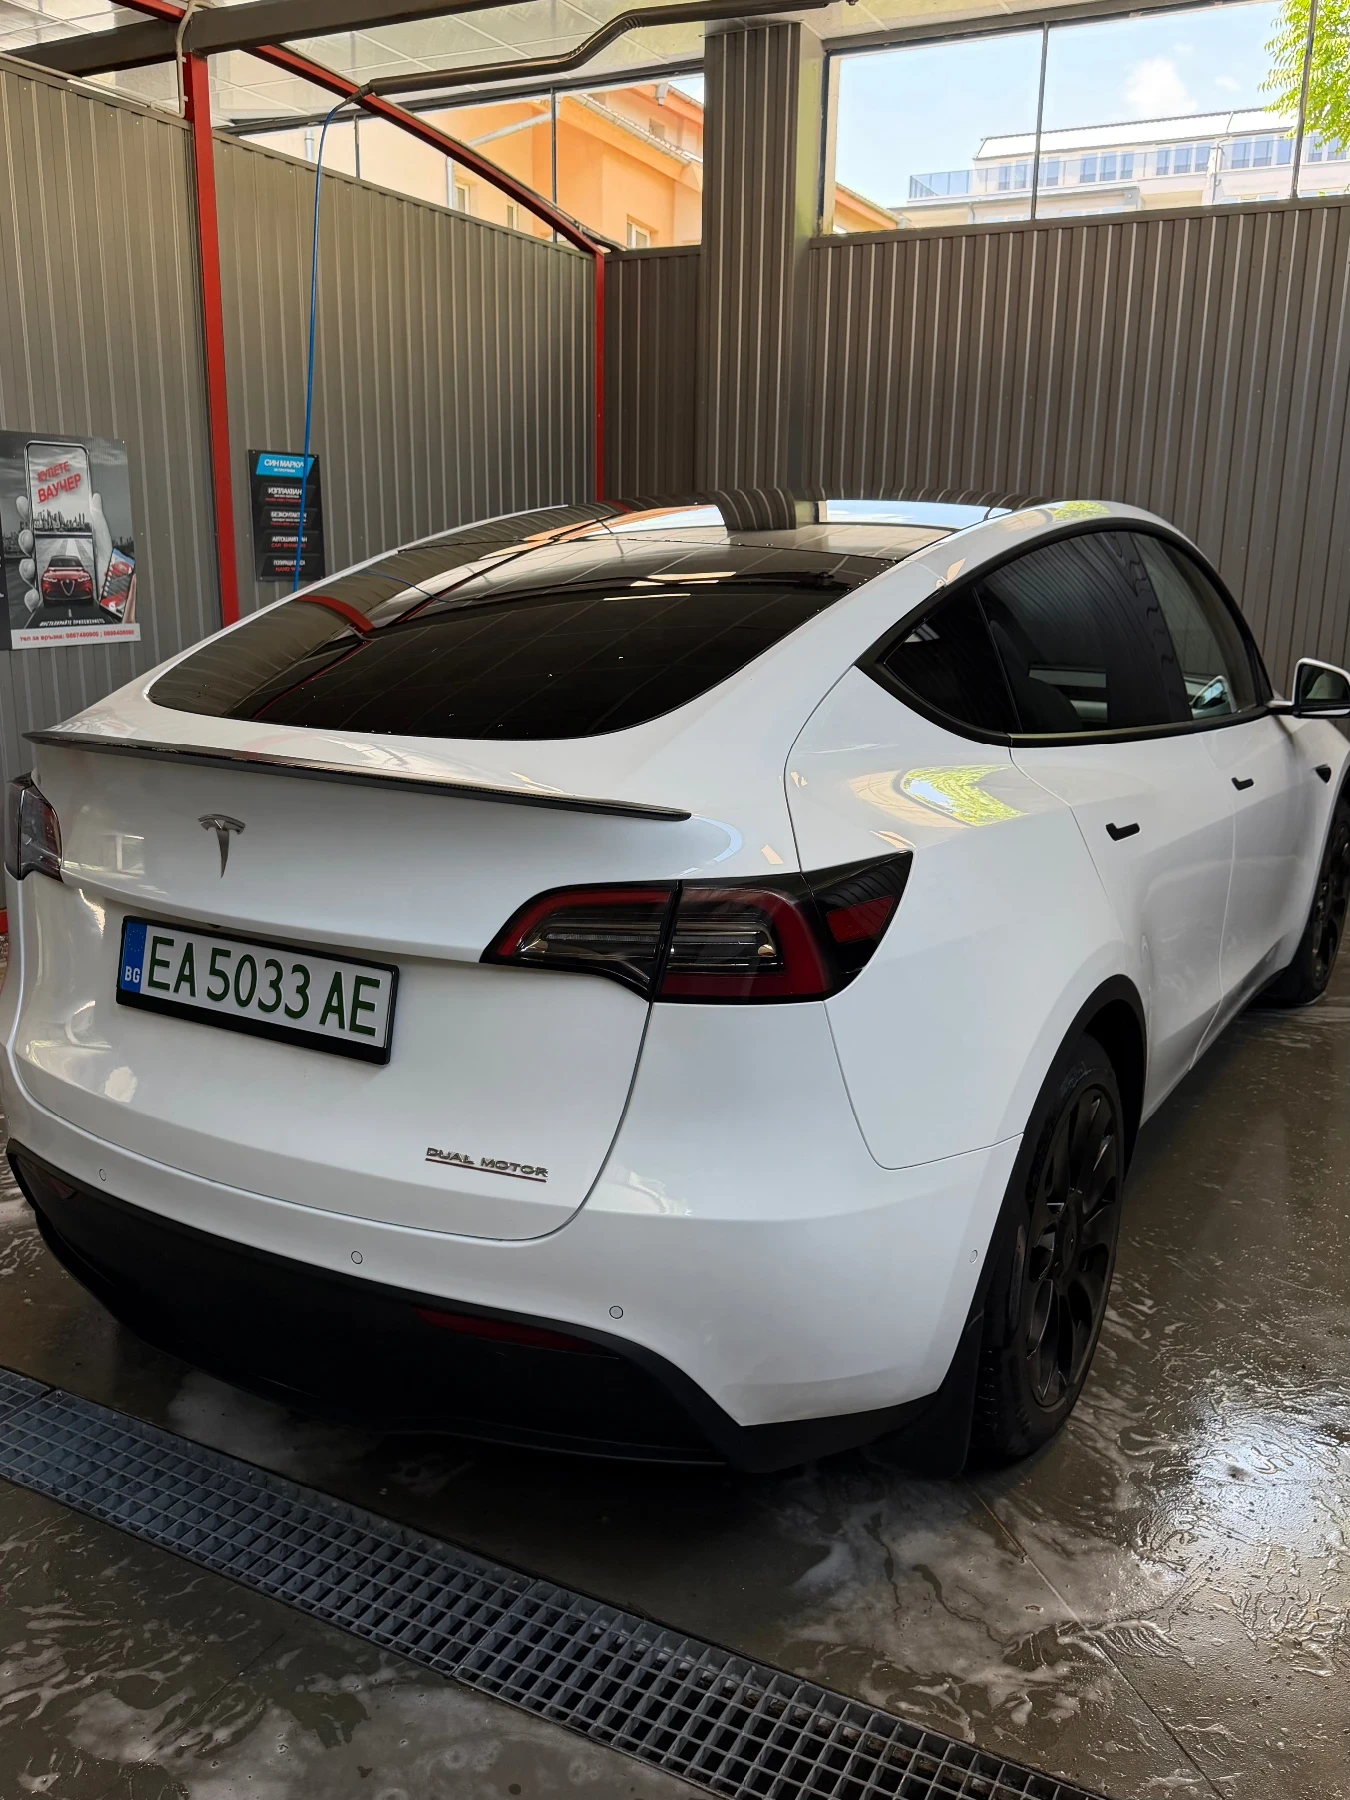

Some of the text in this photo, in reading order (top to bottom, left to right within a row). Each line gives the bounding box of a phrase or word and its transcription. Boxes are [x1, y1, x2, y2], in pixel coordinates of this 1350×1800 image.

[37, 473, 81, 503] ВАУЧЕР
[124, 935, 381, 1037] BG EA 5033 AE
[426, 1147, 549, 1178] DUAL MOTOR
